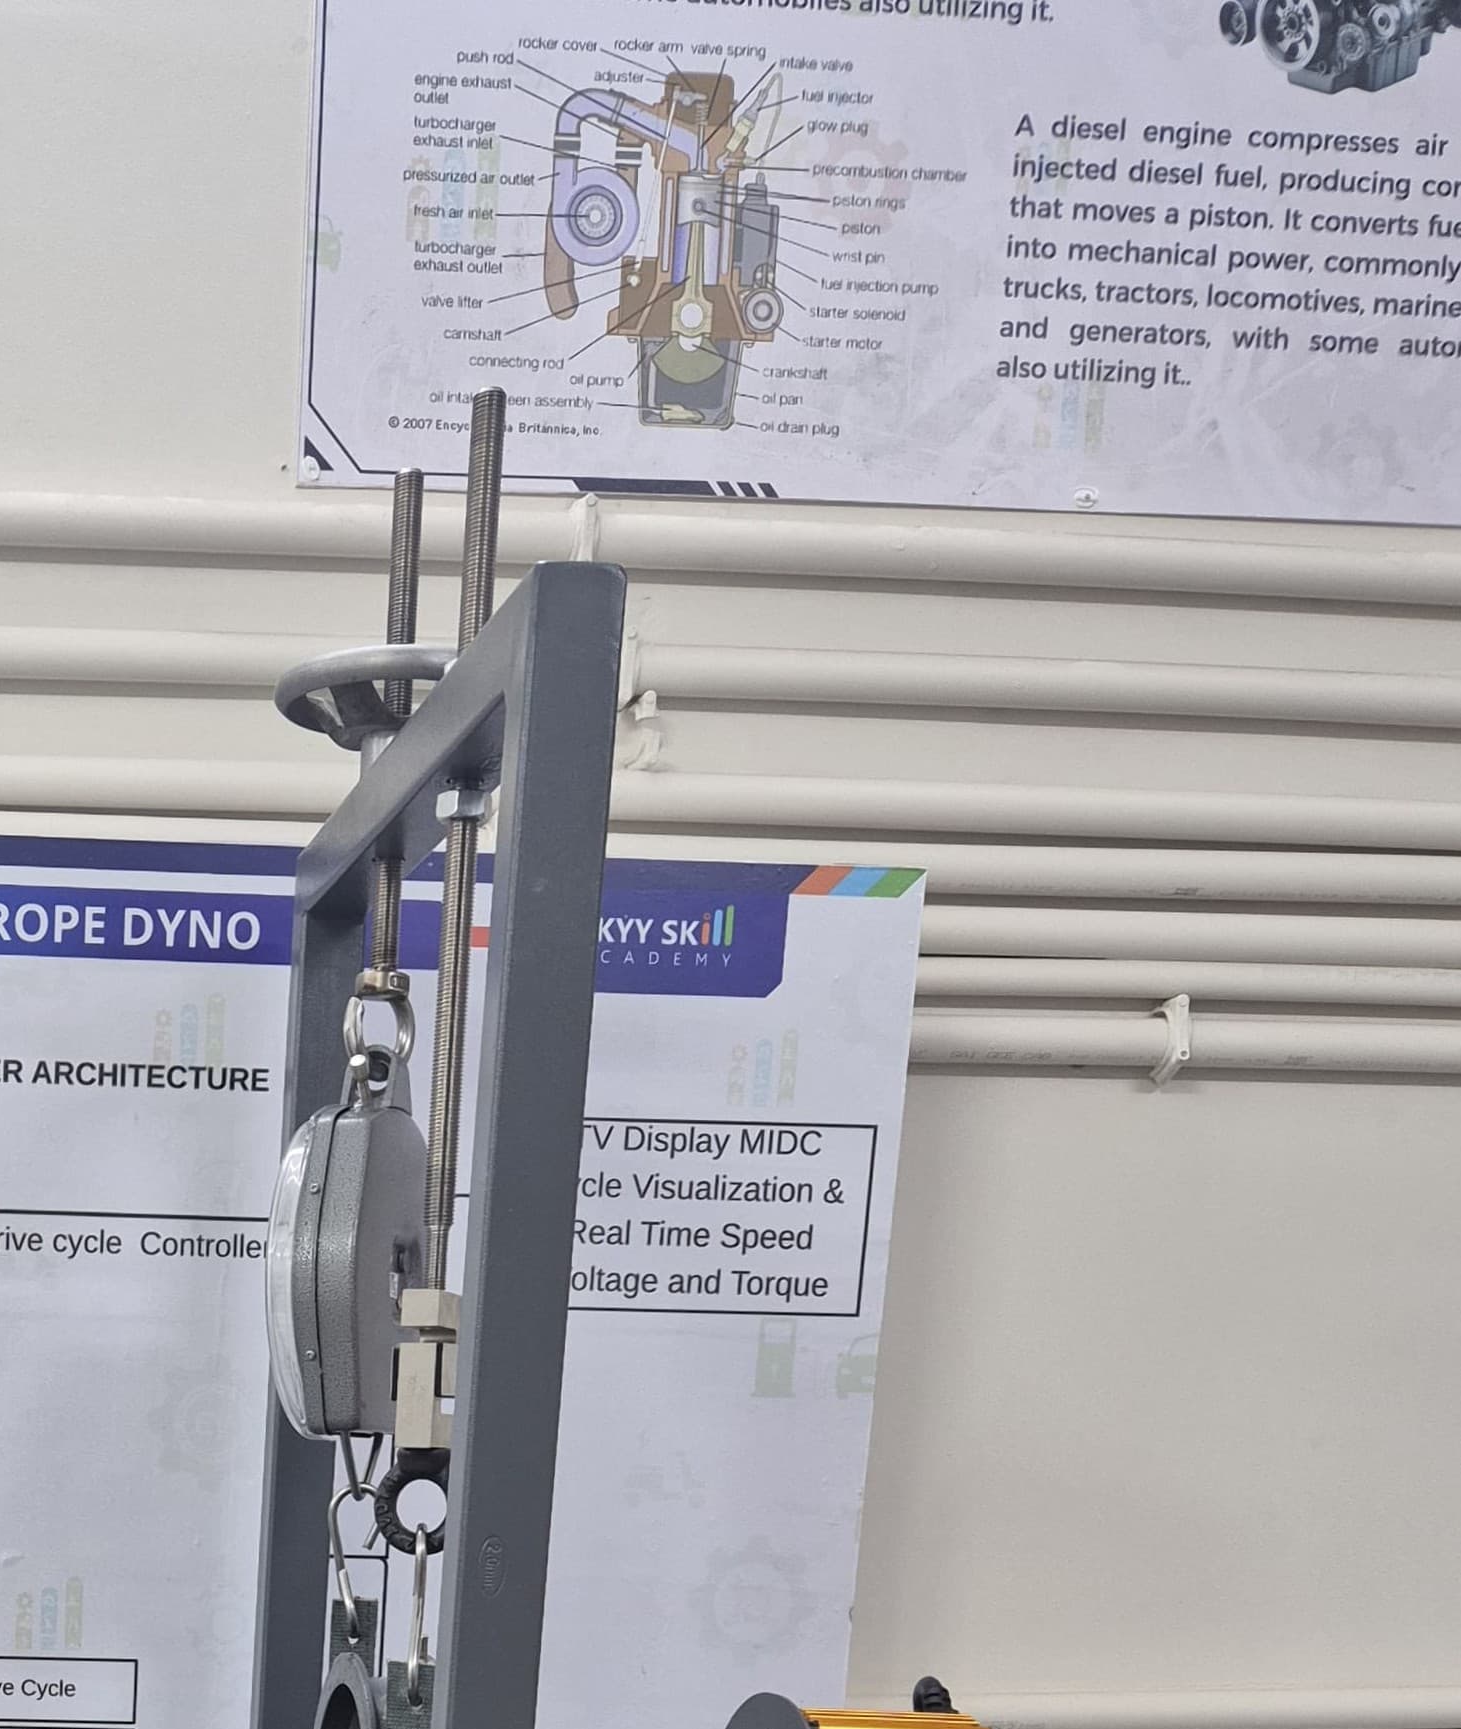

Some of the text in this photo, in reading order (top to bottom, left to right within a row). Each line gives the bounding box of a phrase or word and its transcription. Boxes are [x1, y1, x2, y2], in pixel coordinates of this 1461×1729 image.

[918, 0, 1023, 24] utilizing
[1031, 0, 1054, 22] it.
[518, 37, 598, 52] rocker cover
[614, 39, 683, 53] rocker arm
[691, 42, 766, 60] valve spring
[457, 50, 514, 65] push rod
[779, 56, 853, 73] intake valve
[414, 73, 512, 89] engine exhaust
[594, 69, 644, 84] adjuster
[414, 92, 449, 104] outlet
[802, 89, 873, 106] fuel injector
[413, 115, 496, 134] turbocharger
[807, 119, 868, 137] glow plug
[413, 134, 493, 150] exhaust inlet
[1014, 114, 1449, 157] A diesel engine compresses air
[403, 168, 535, 186] pressurized air outlet
[813, 162, 968, 183] precombustion chamber
[1012, 153, 1117, 183] injected
[1128, 159, 1203, 186] diesel
[1215, 163, 1268, 191] fuel,
[1279, 171, 1411, 200] producing
[413, 203, 493, 220] fresh air inlet
[832, 195, 906, 213] piston rings
[1010, 196, 1062, 219] that
[1072, 202, 1156, 225] moves
[1164, 209, 1179, 225] a
[1189, 203, 1273, 232] piston.
[1284, 208, 1302, 231] It
[1310, 213, 1419, 237] converts
[842, 222, 881, 236] piston
[414, 240, 497, 257] turbocharger
[413, 259, 503, 275] exhaust outlet
[832, 250, 885, 266] wrist pin
[1006, 235, 1461, 284] into mechanical power, commonly
[821, 277, 939, 297] fuel injection pump
[421, 294, 483, 309] valve lifter
[1003, 276, 1461, 319] trucks, tractors, locomotives, marine
[809, 306, 906, 322] starter solenoid
[443, 328, 502, 342] camshaft
[801, 335, 883, 350] starter motor
[999, 316, 1049, 340] and
[1069, 320, 1211, 350] generators,
[1233, 326, 1289, 351] with
[1308, 333, 1379, 354] some
[469, 354, 565, 372] connecting rod
[996, 355, 1047, 380] also
[1054, 358, 1156, 389] utilizing
[569, 374, 624, 388] oil pump
[762, 366, 828, 380] crankshaft
[429, 391, 444, 404] oil
[535, 396, 593, 411] assembly
[761, 392, 803, 407] oil pan
[403, 416, 432, 431] 2007
[759, 421, 840, 437] oil drain plug
[123, 907, 261, 951] DYNO
[598, 916, 654, 944] KYY
[600, 949, 732, 968] CADEMY
[31, 1059, 270, 1093] ARCHITECTURE
[624, 1125, 731, 1161] Display
[740, 1128, 823, 1156] MIDC
[577, 1171, 845, 1205] cle Visualization &
[52, 1226, 122, 1256] cycle
[573, 1219, 814, 1256] Real Time Speed
[571, 1265, 829, 1304] oltage and Torque
[21, 1678, 76, 1700] Cycle
